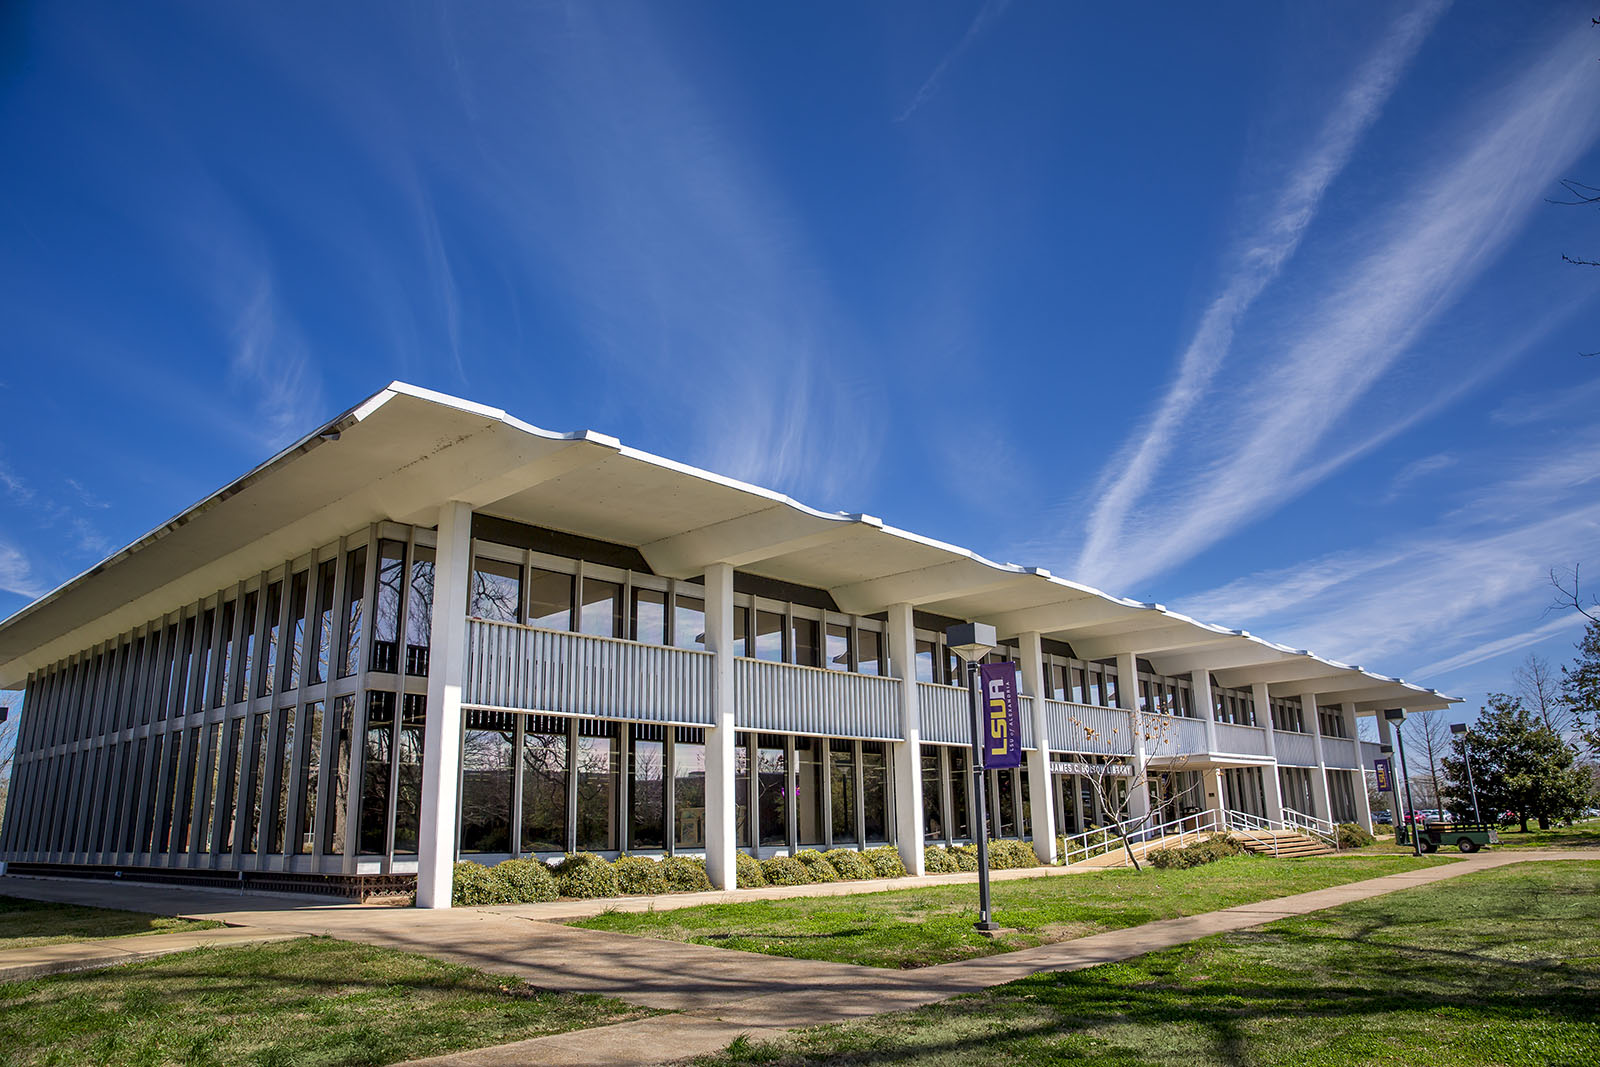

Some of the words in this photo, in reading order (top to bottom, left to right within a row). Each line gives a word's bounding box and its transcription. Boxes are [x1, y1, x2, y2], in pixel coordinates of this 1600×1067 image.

[1006, 682, 1014, 726] ALEXANDRIA
[989, 680, 1007, 755] LSUA
[1008, 728, 1015, 736] of
[1050, 763, 1072, 773] JAMES
[1377, 764, 1386, 788] LSUA
